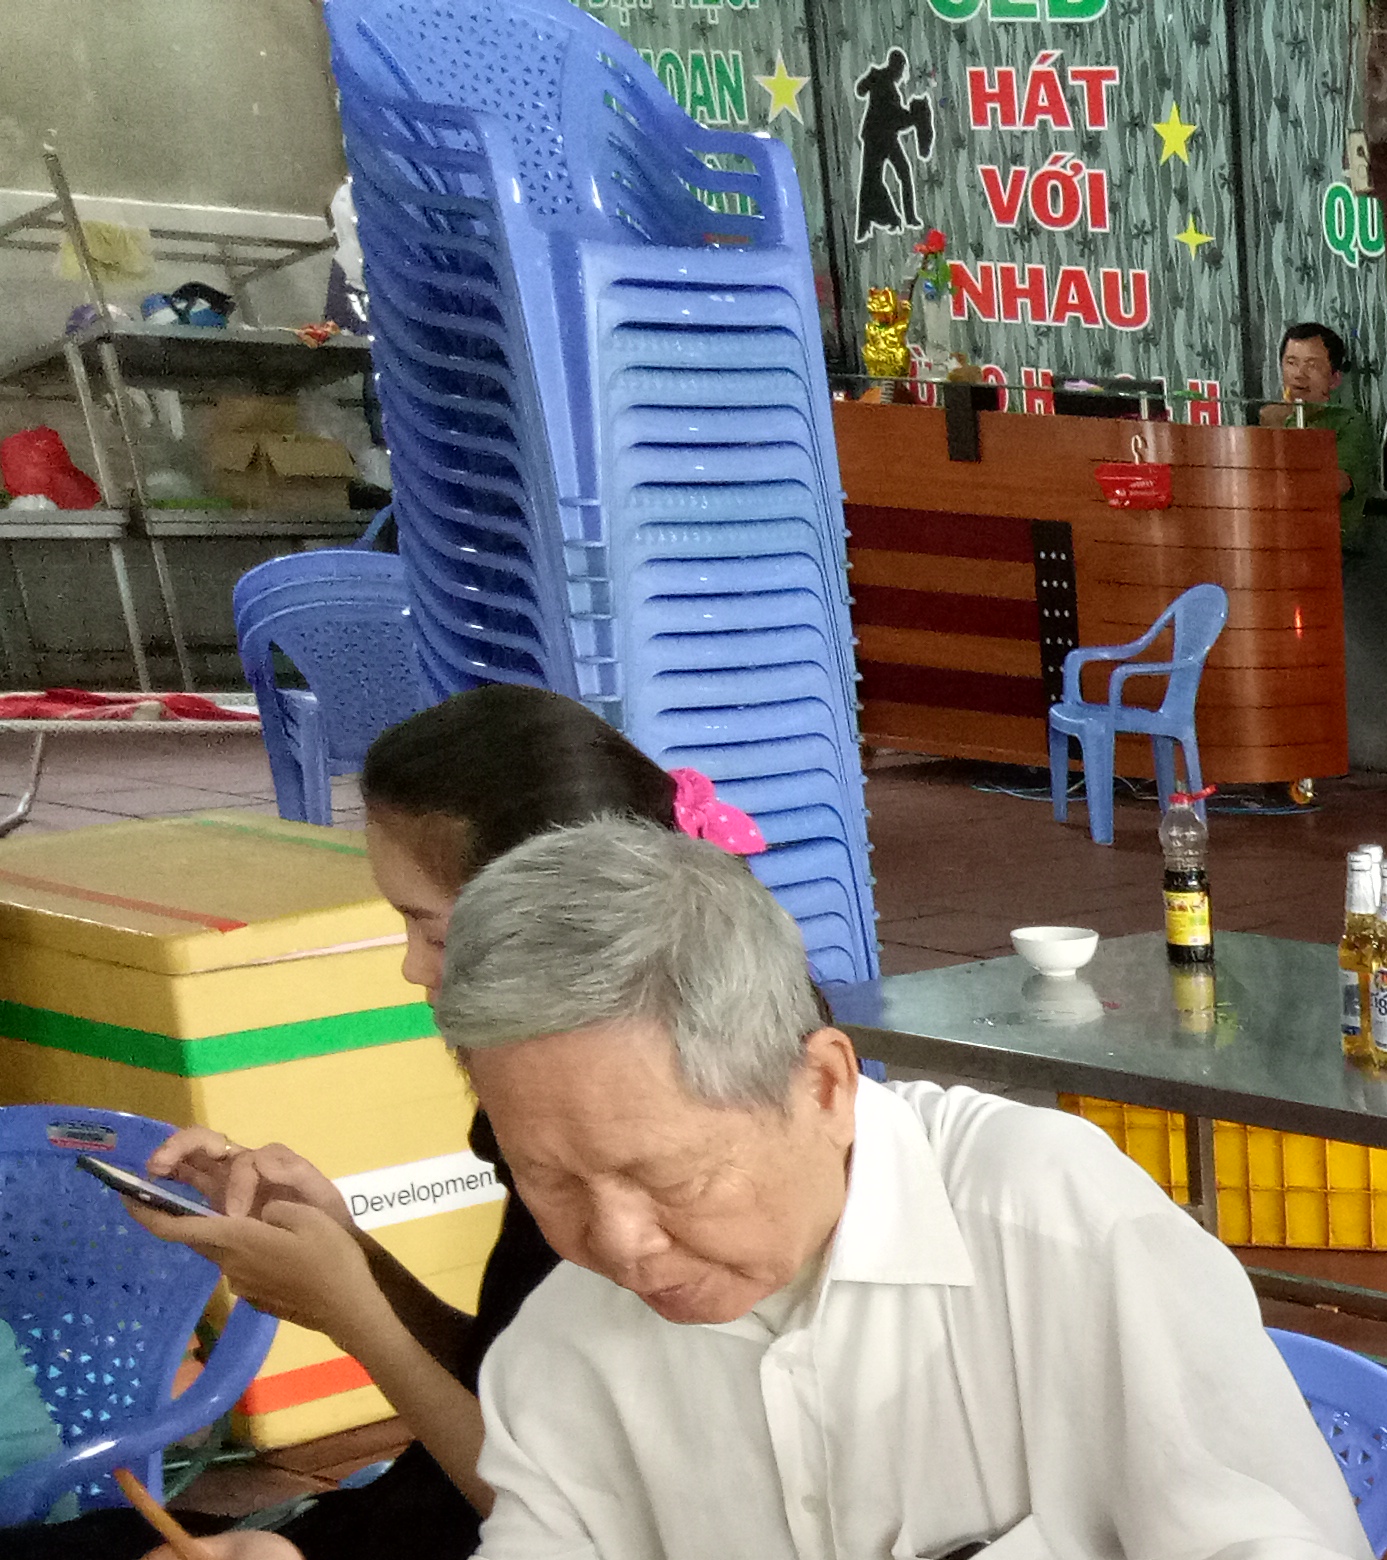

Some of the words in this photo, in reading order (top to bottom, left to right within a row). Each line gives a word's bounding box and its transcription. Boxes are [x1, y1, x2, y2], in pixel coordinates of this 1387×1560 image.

[966, 49, 1120, 131] HÁT
[977, 151, 1111, 233] VỚI
[948, 260, 1151, 331] NHAU
[350, 1169, 496, 1217] Developmen
